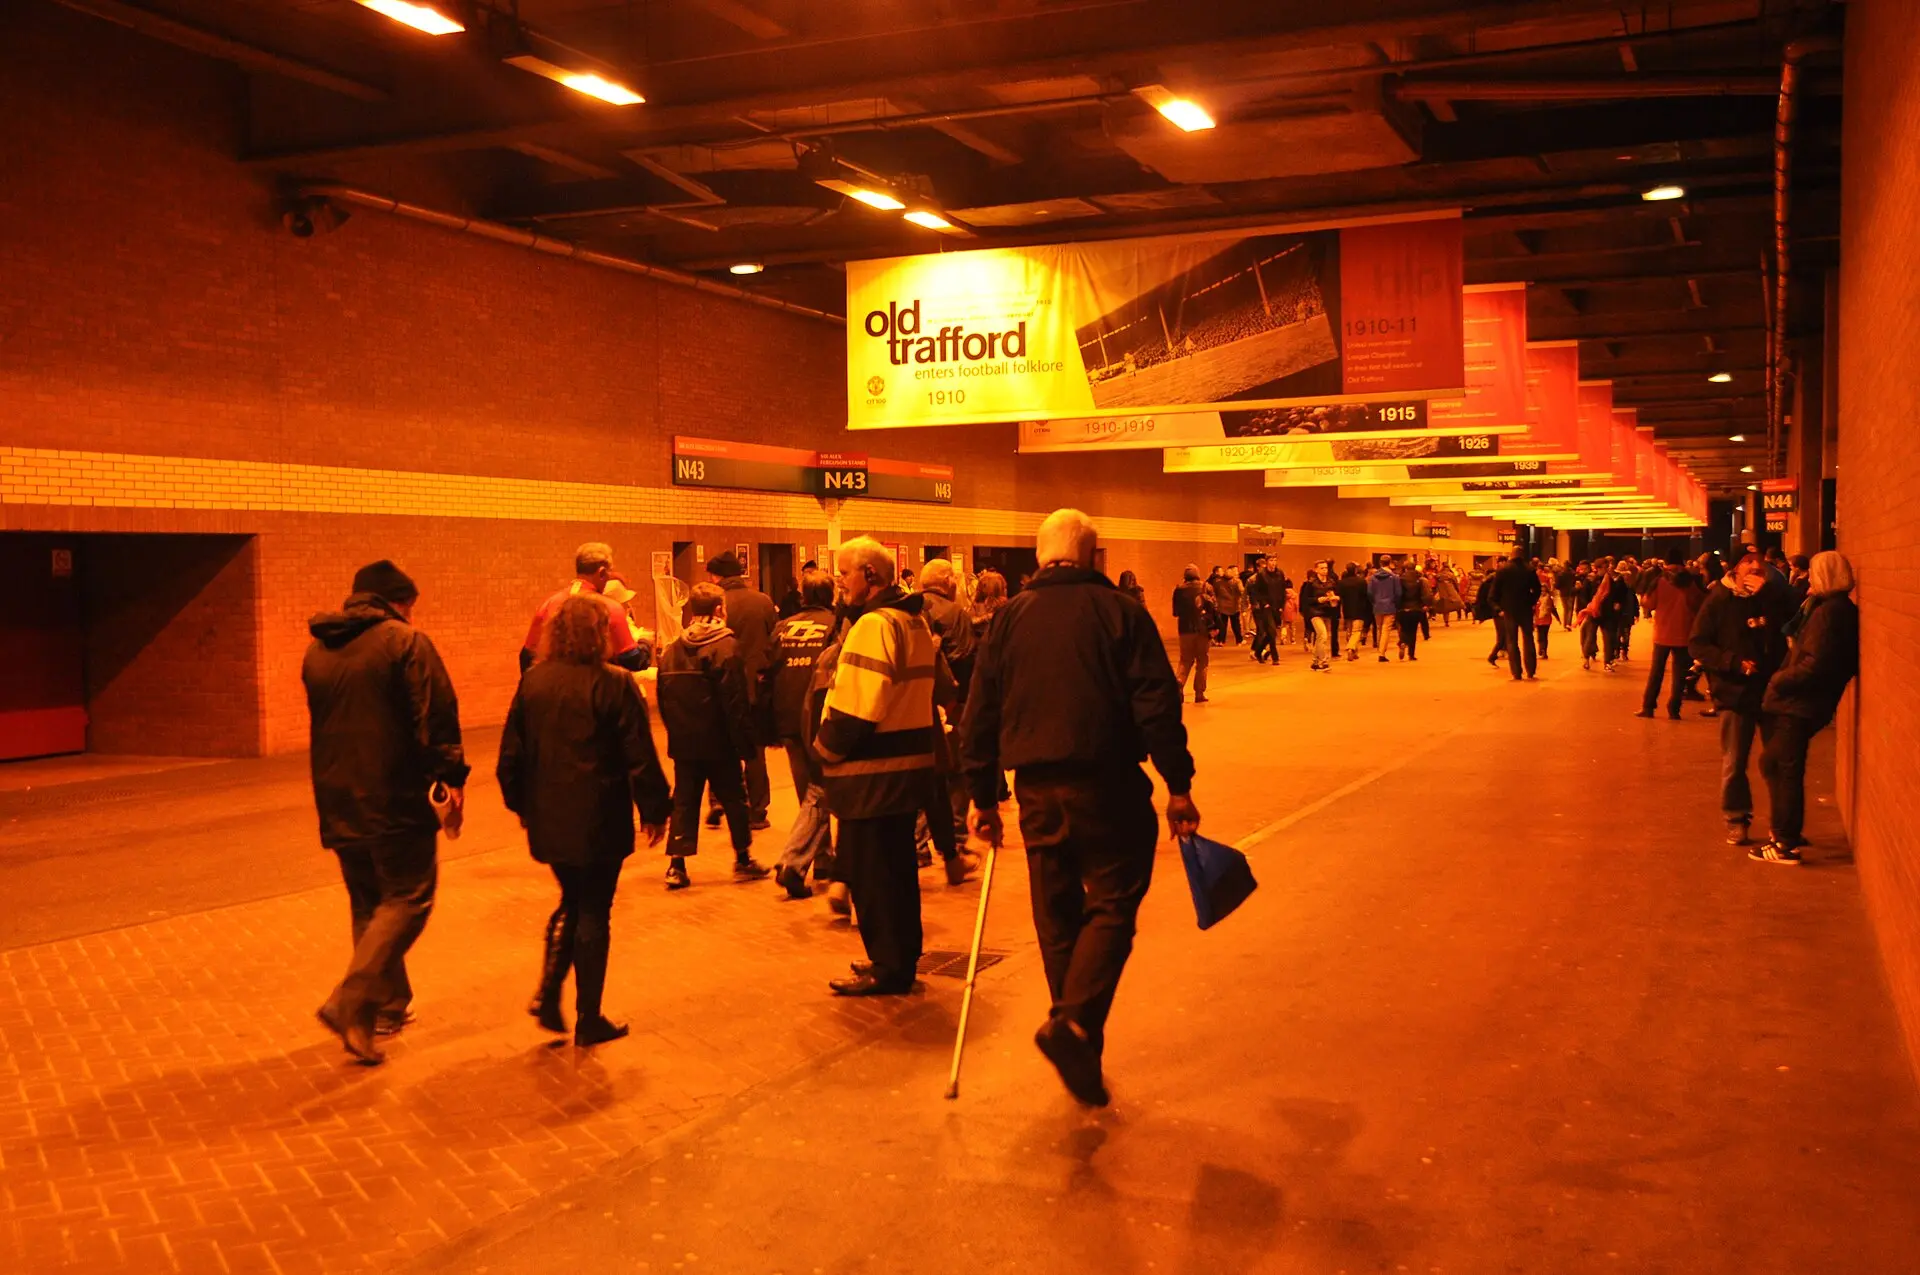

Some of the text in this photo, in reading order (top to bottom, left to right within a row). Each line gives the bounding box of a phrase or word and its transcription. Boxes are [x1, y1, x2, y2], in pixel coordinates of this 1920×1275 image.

[864, 299, 921, 338] old
[1345, 316, 1417, 336] 1910-11
[887, 321, 1026, 366] trafford
[914, 359, 1064, 380] enters football folklore
[927, 389, 966, 405] 1910
[1378, 406, 1416, 422] 1915
[1084, 419, 1155, 434] 1910-1919
[1219, 445, 1277, 457] 1920-1929
[1458, 437, 1490, 450] 1926
[678, 459, 705, 481] N43
[1513, 460, 1540, 471] 1939
[824, 471, 866, 490] N43
[935, 482, 952, 499] N43
[1763, 493, 1792, 509] N44
[1766, 521, 1784, 531] N45
